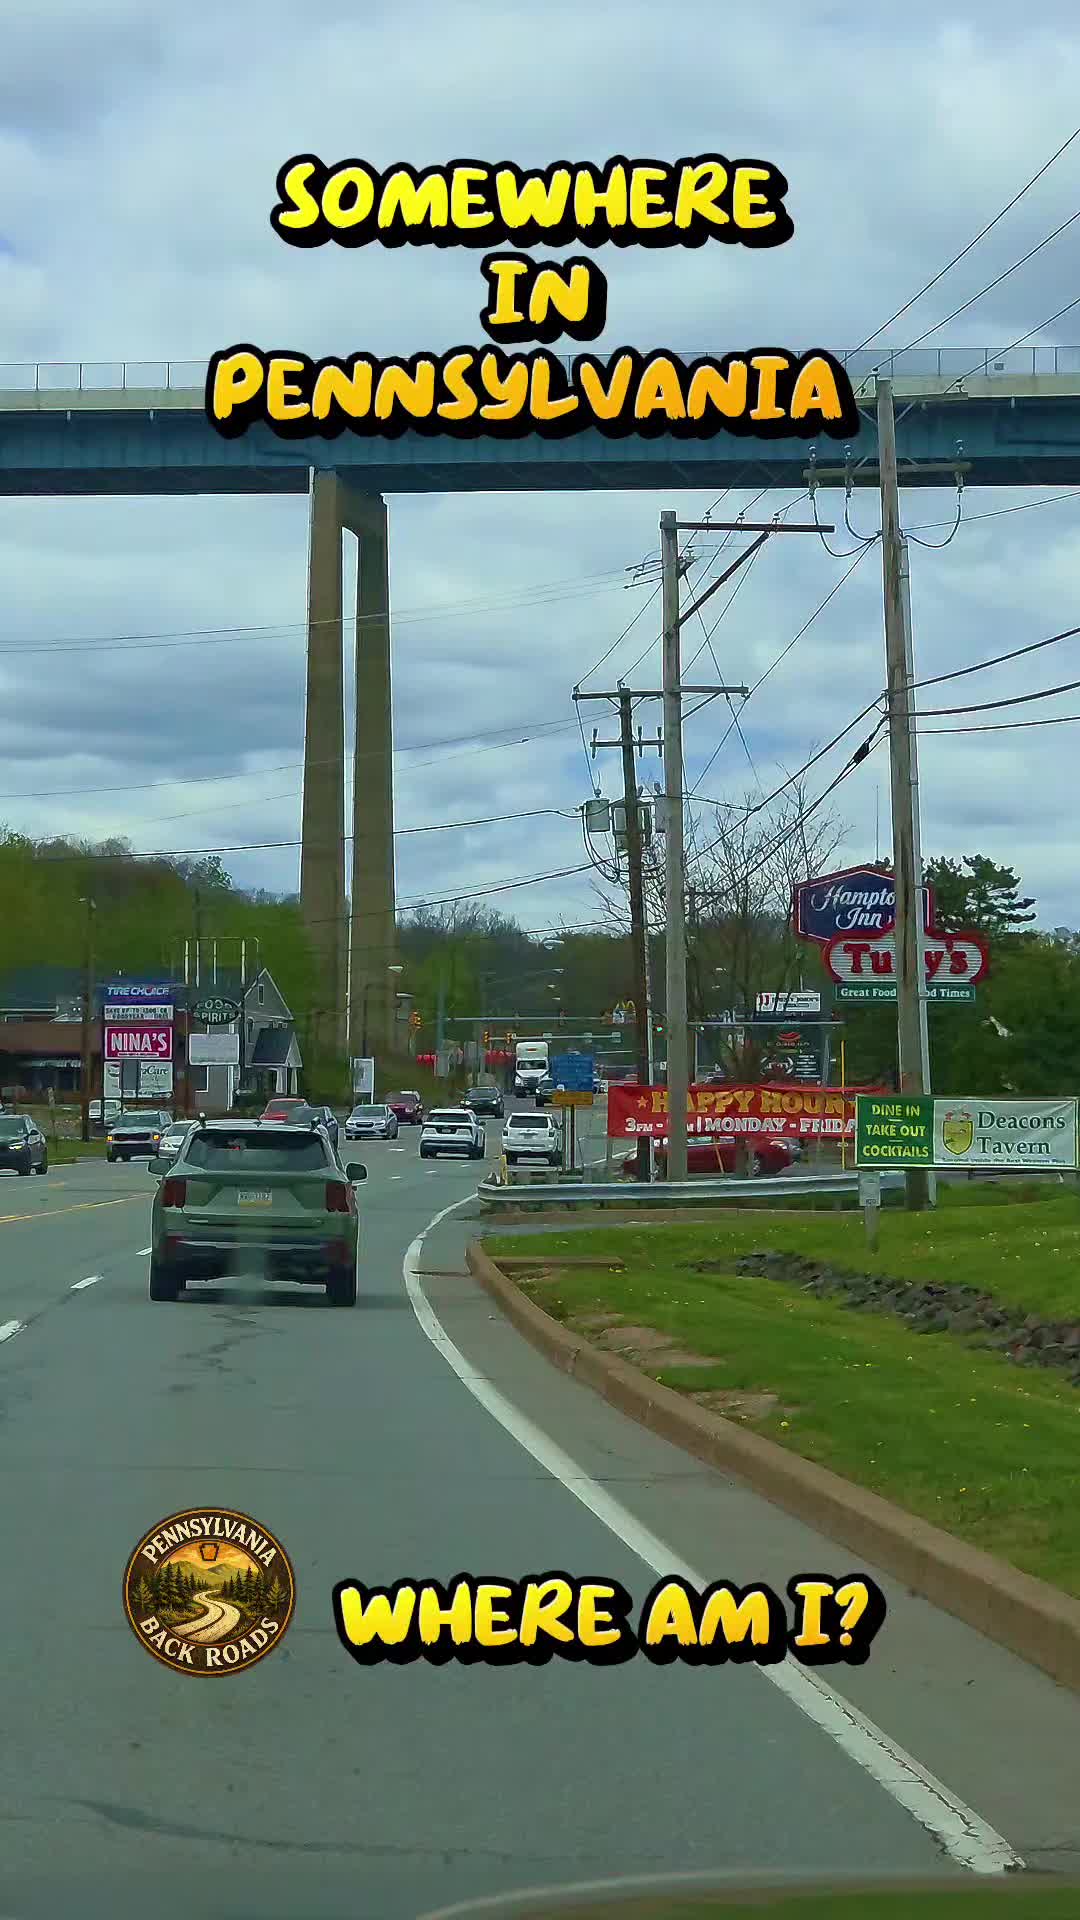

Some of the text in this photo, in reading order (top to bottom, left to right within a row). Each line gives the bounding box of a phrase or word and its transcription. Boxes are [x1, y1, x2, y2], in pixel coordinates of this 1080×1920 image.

[811, 885, 896, 911] Hampto
[836, 907, 884, 929] Inn
[843, 940, 968, 981] Tuy's
[841, 988, 870, 997] Great
[872, 988, 897, 997] Food
[940, 988, 970, 997] Times
[111, 1032, 168, 1052] NINA'S
[760, 1091, 845, 1113] HOUR
[872, 1104, 920, 1117] DINE IN
[705, 1117, 787, 1132] MONDAY
[800, 1118, 855, 1132] FRIDA
[977, 1111, 1066, 1130] Deacons
[866, 1124, 926, 1137] TAKE OUT
[863, 1144, 929, 1158] COCKTAILS
[976, 1136, 1051, 1155] Tavern
